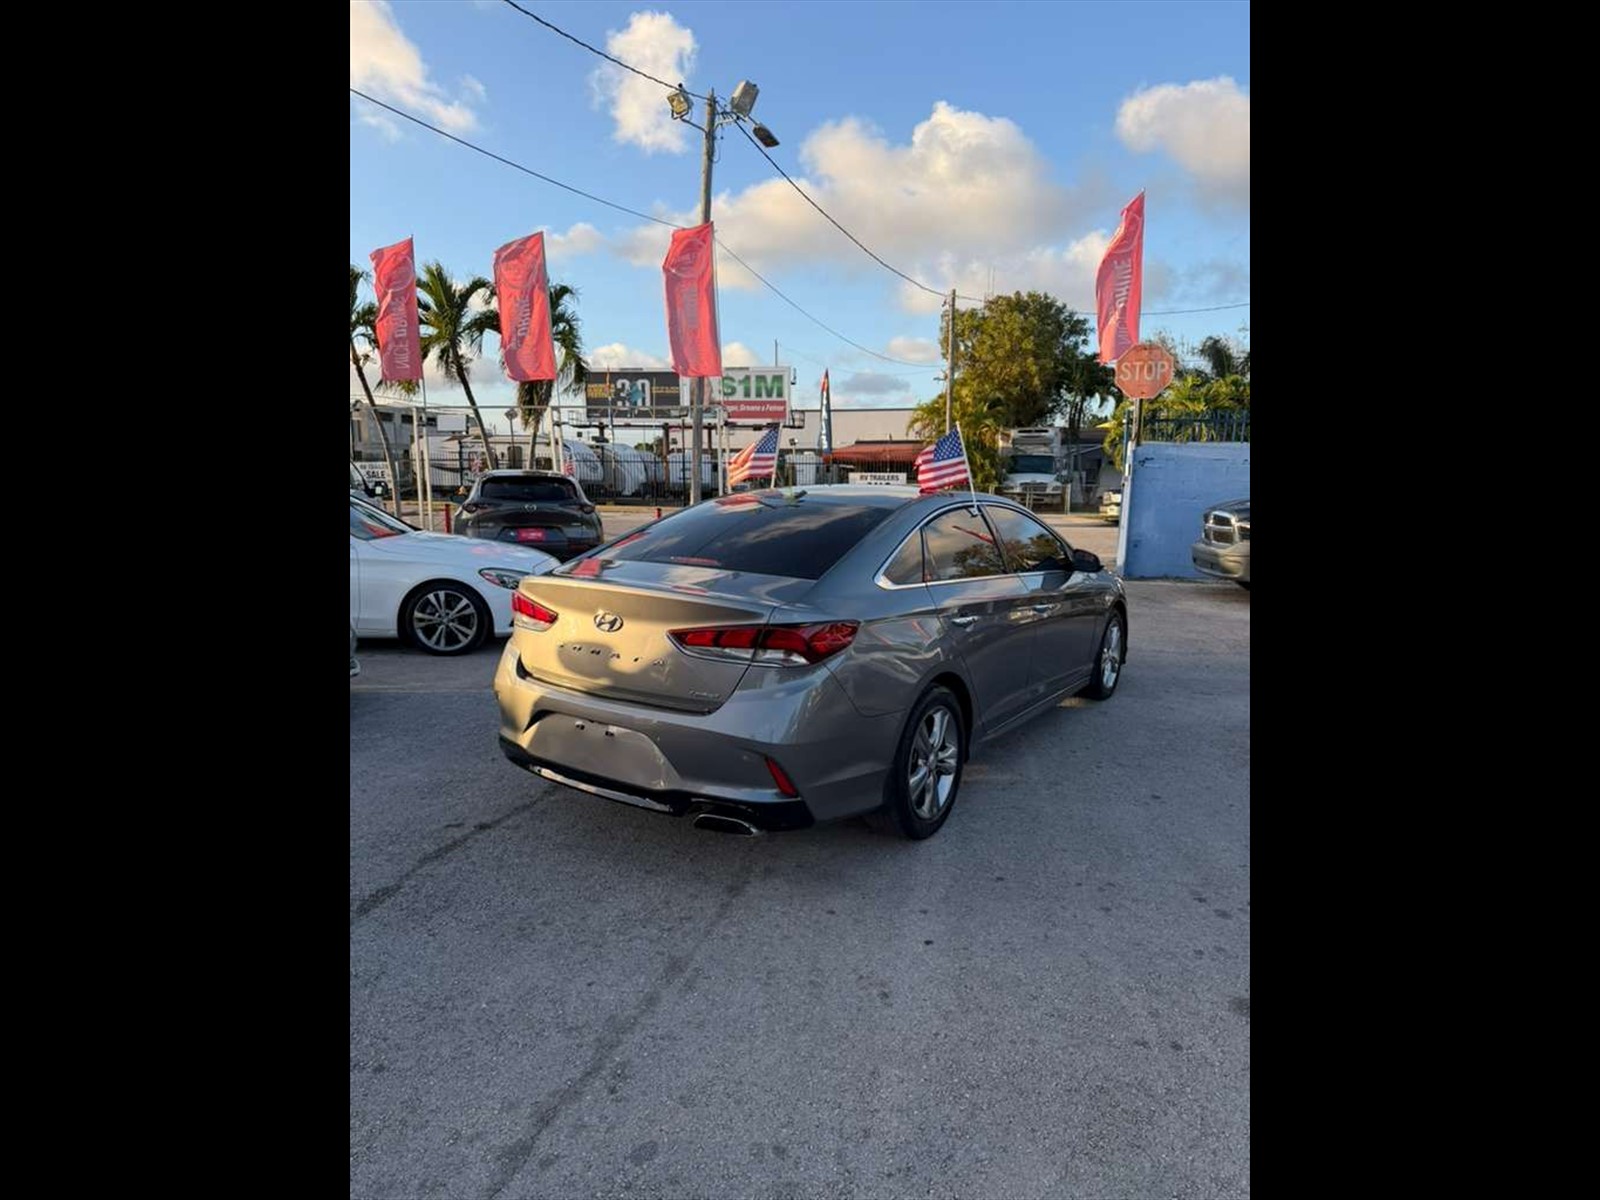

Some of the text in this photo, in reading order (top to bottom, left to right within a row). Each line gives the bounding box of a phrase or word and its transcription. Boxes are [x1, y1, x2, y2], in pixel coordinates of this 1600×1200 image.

[1120, 360, 1168, 382] STOP
[722, 374, 784, 399] $1M
[366, 469, 386, 479] SALE
